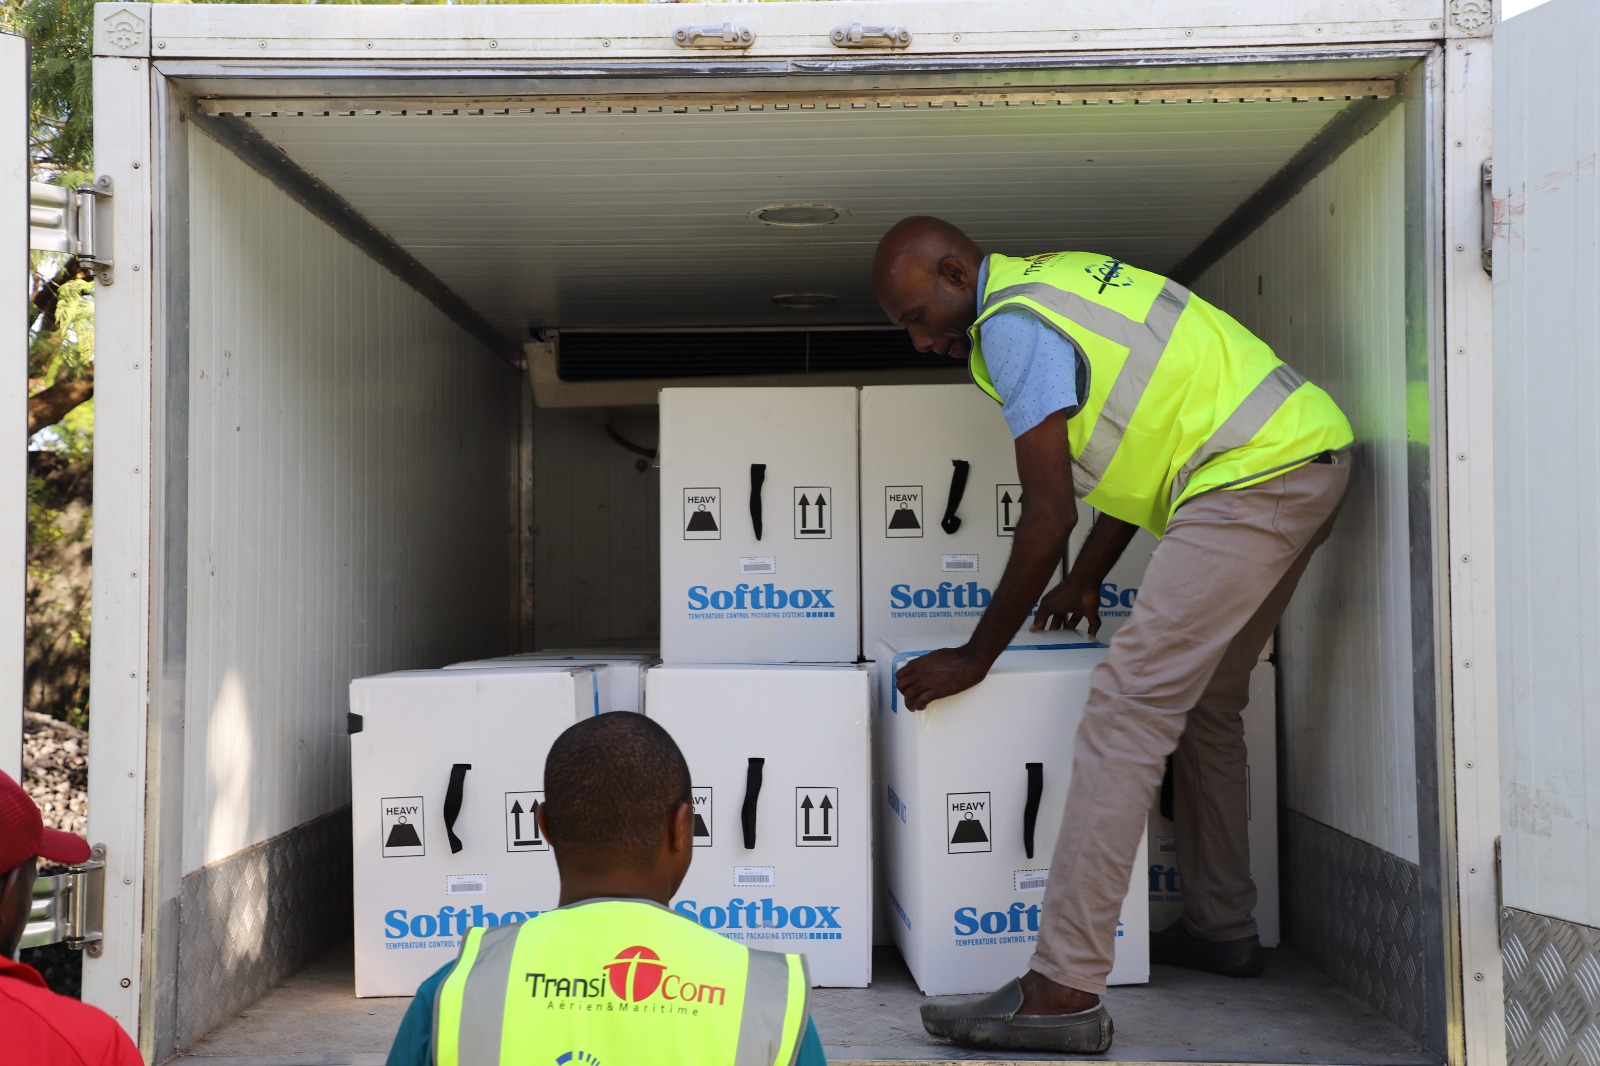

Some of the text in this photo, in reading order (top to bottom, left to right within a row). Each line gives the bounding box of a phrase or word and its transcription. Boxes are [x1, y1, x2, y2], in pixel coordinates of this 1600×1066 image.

[687, 496, 716, 504] HEAVY
[889, 494, 918, 502] HEAVY
[687, 583, 835, 610] Softbox
[890, 581, 992, 609] Softb
[891, 611, 928, 619] TEMPERATURE
[386, 806, 418, 815] HEAVY
[952, 802, 985, 811] HEAVY
[954, 901, 1042, 936] Soft
[746, 932, 780, 940] PACKAGING
[955, 936, 998, 946] TEMPERATURE
[1000, 935, 1026, 944] CONTROL
[385, 940, 427, 950] TEMPERATURE
[428, 939, 456, 948] CONTROL
